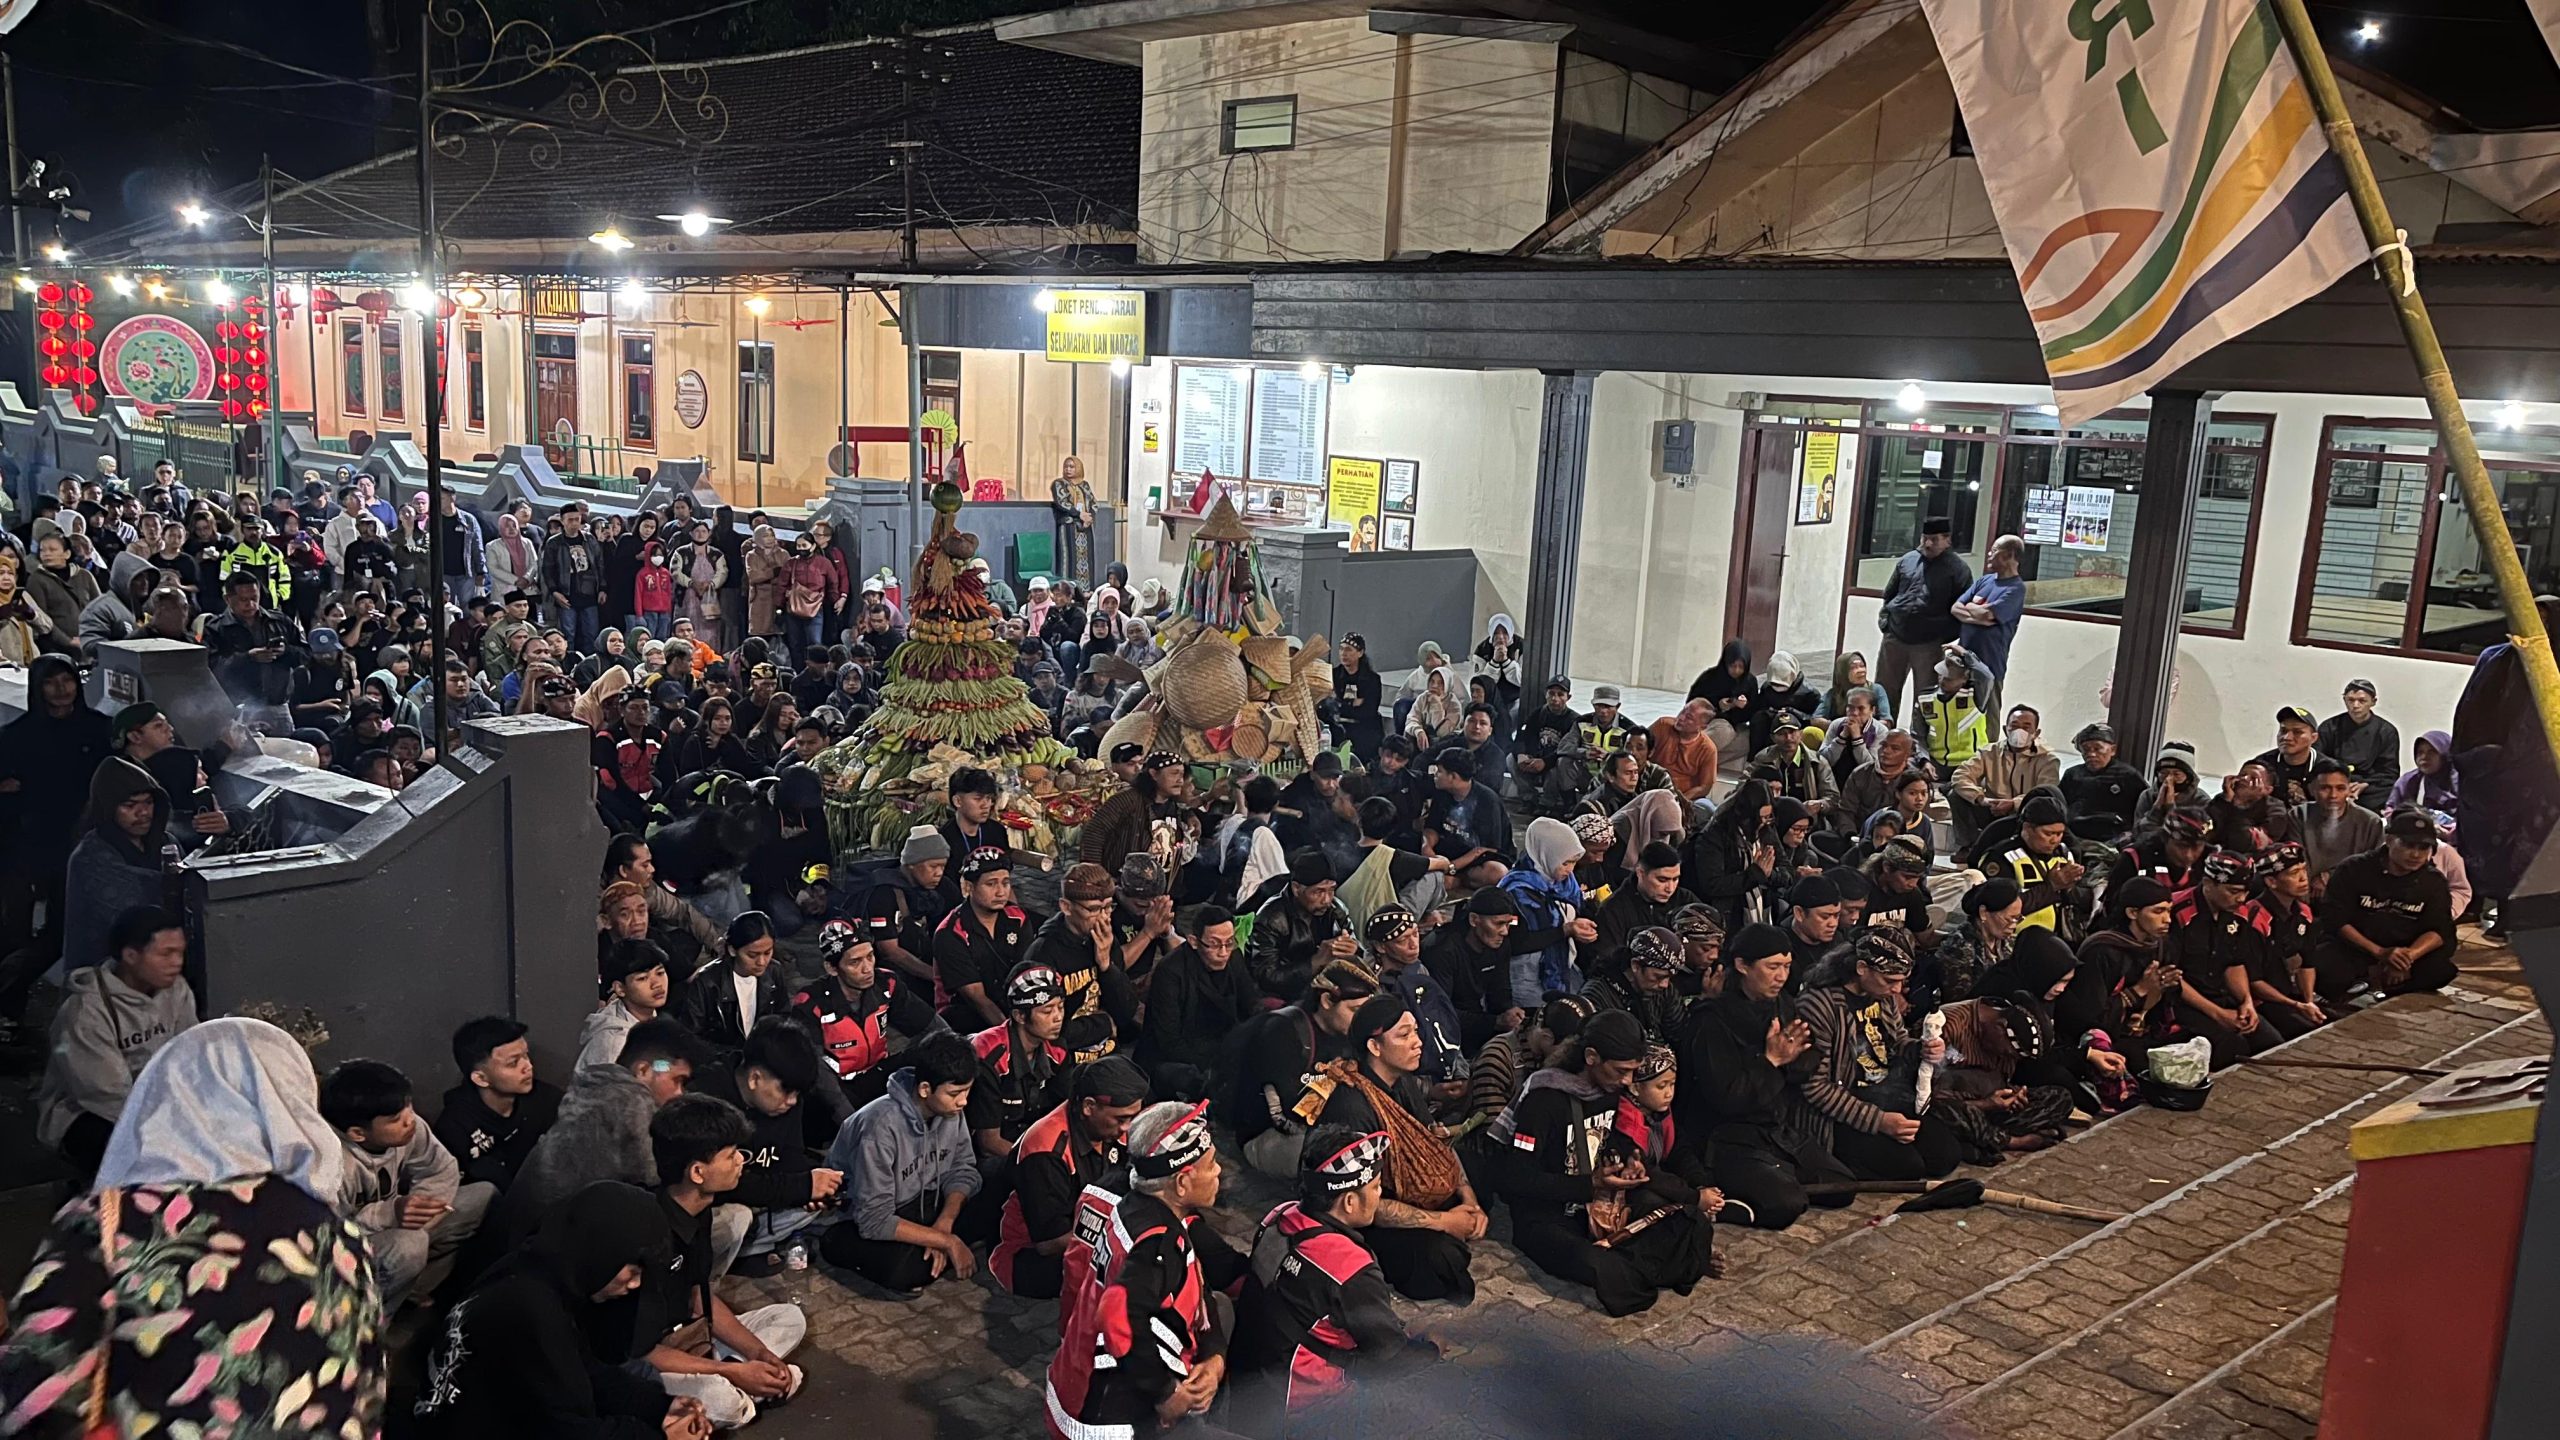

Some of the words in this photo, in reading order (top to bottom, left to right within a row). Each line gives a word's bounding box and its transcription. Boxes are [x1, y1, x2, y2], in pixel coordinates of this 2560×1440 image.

[1054, 299, 1077, 314] LOKET
[1050, 331, 1091, 354] SELAMATAN
[1093, 333, 1108, 355] DAN
[1336, 467, 1375, 479] PERHATIAN
[1168, 1147, 1200, 1169] Pecalang
[1327, 1177, 1359, 1192] Pecalang
